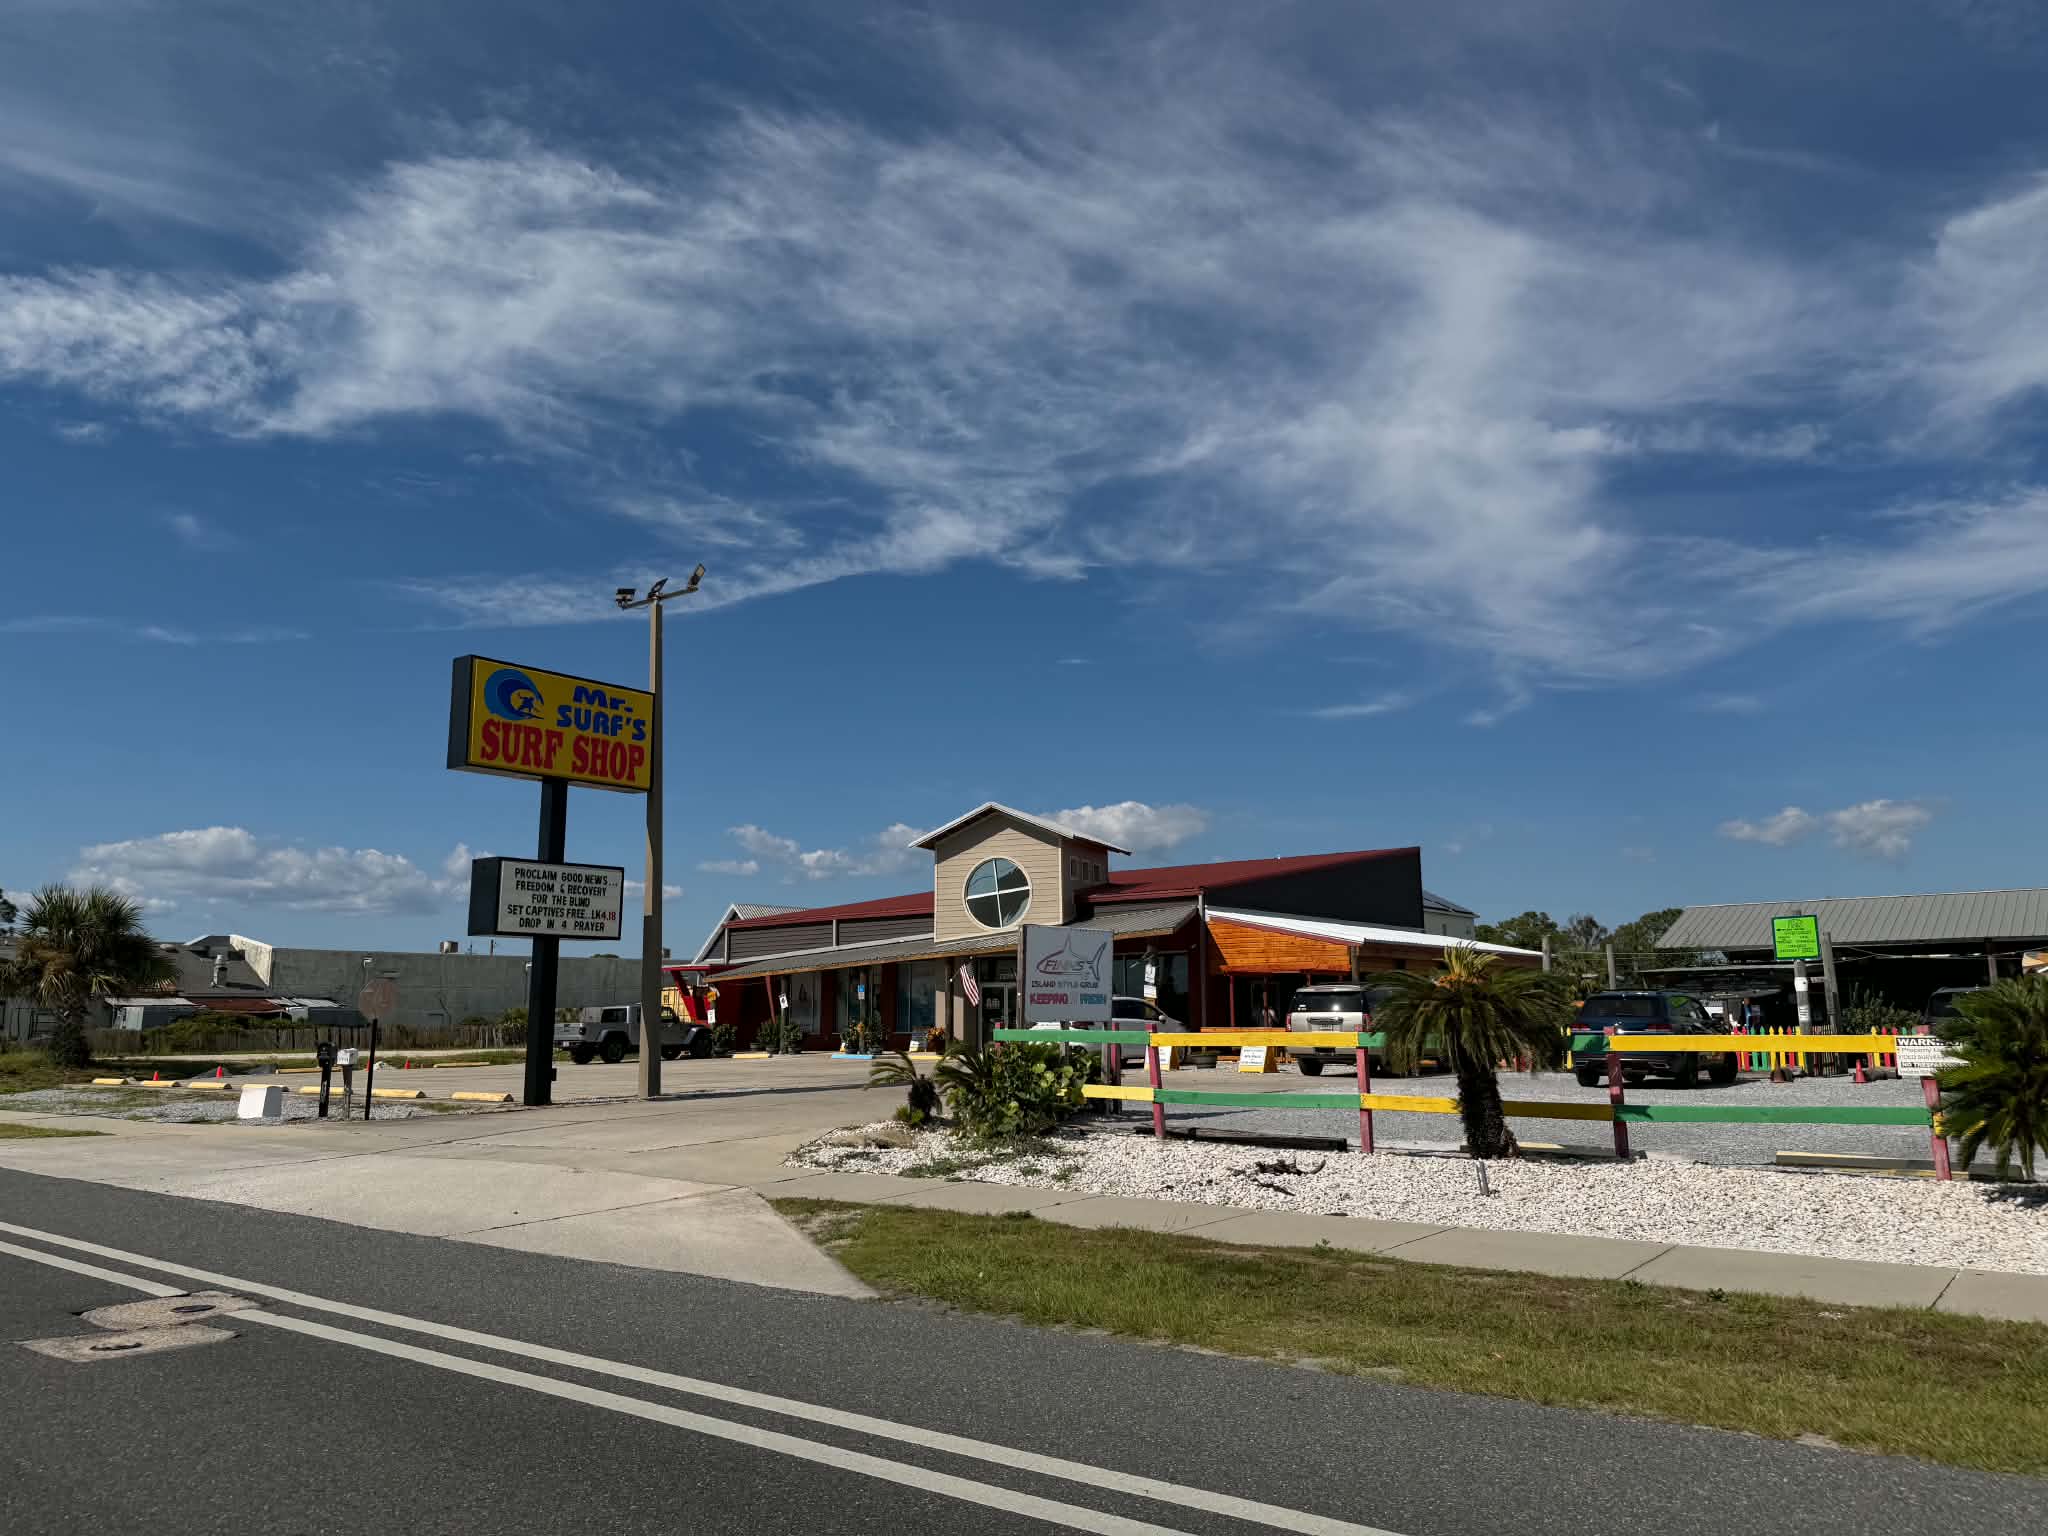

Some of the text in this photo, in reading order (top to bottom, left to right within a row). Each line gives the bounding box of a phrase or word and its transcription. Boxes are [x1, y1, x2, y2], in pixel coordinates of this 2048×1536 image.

[557, 704, 646, 741] SURF'S
[480, 718, 645, 782] SURF SHOP
[515, 867, 557, 881] PROCLAIM
[561, 872, 583, 883] GOOD
[516, 881, 555, 893] FREEDOM
[567, 885, 607, 896] RECOVERY
[532, 894, 590, 907] FOR THE BLIND
[507, 904, 524, 915] SET
[525, 905, 564, 917] CAPTIVES
[519, 918, 605, 932] DROP IN 4 PRAYER
